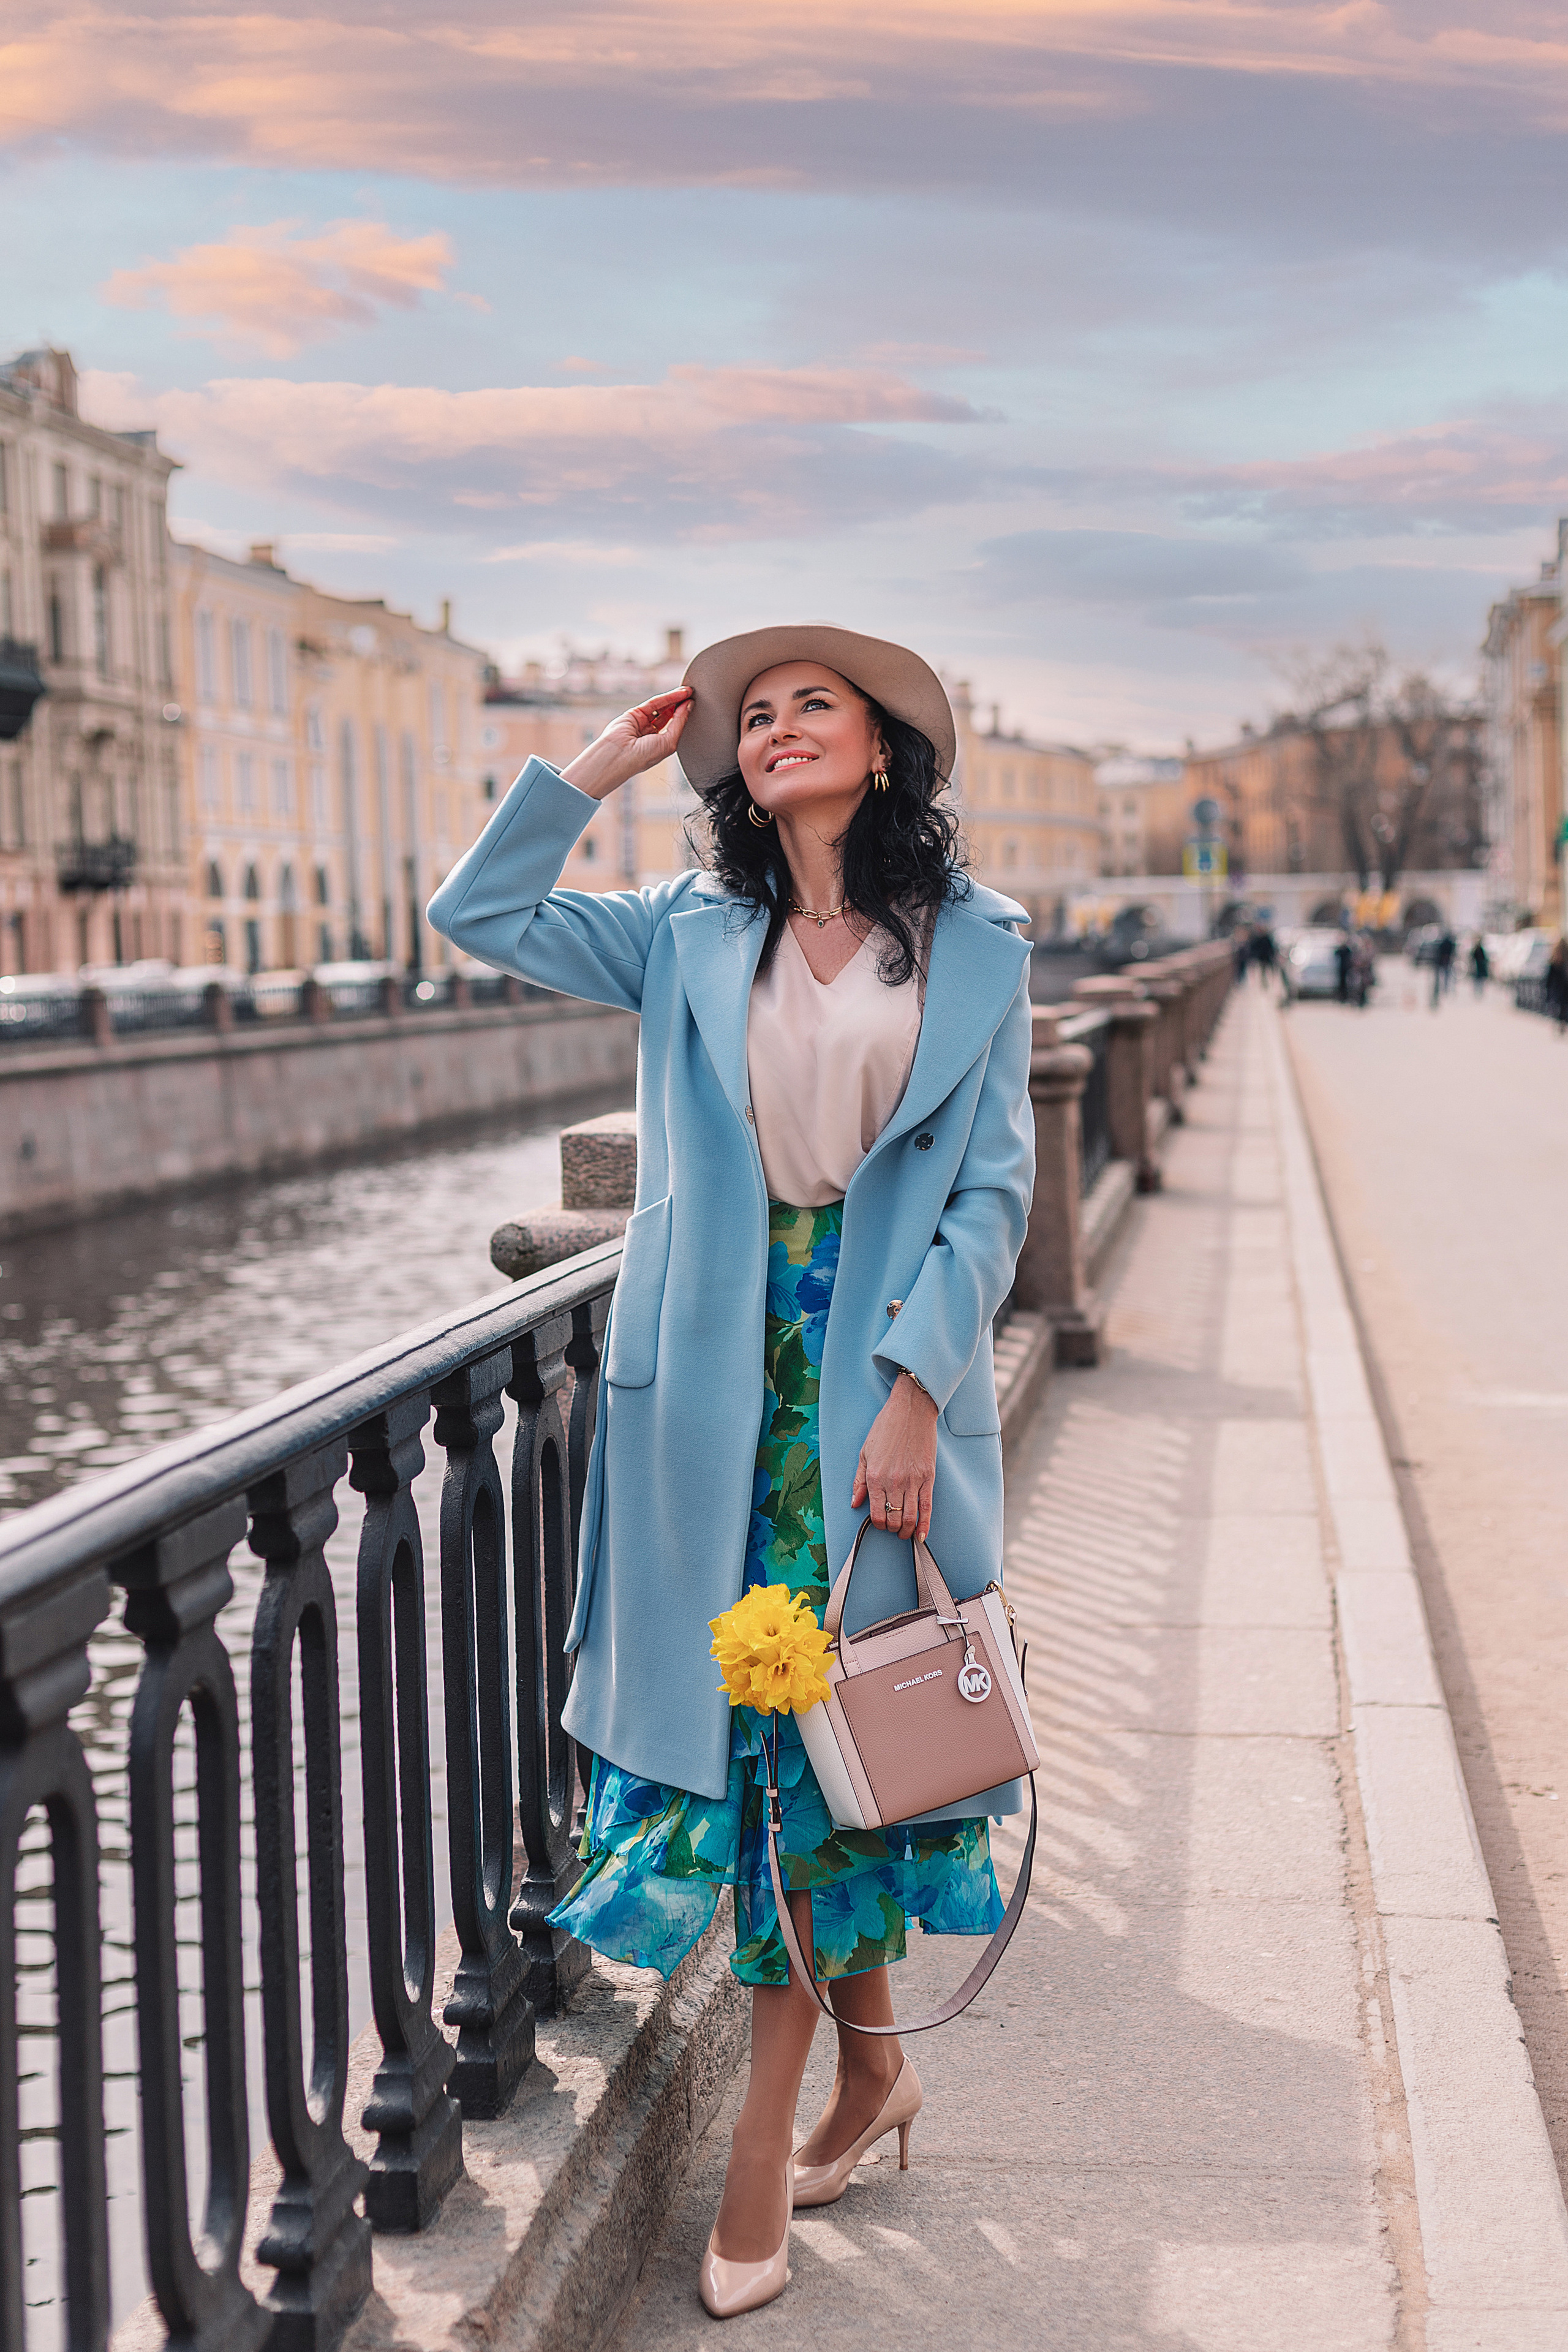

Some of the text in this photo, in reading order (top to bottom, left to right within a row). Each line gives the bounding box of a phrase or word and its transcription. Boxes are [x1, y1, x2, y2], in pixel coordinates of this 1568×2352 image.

[894, 1669, 943, 1692] MICHAEL KORS
[963, 1672, 989, 1694] MK
